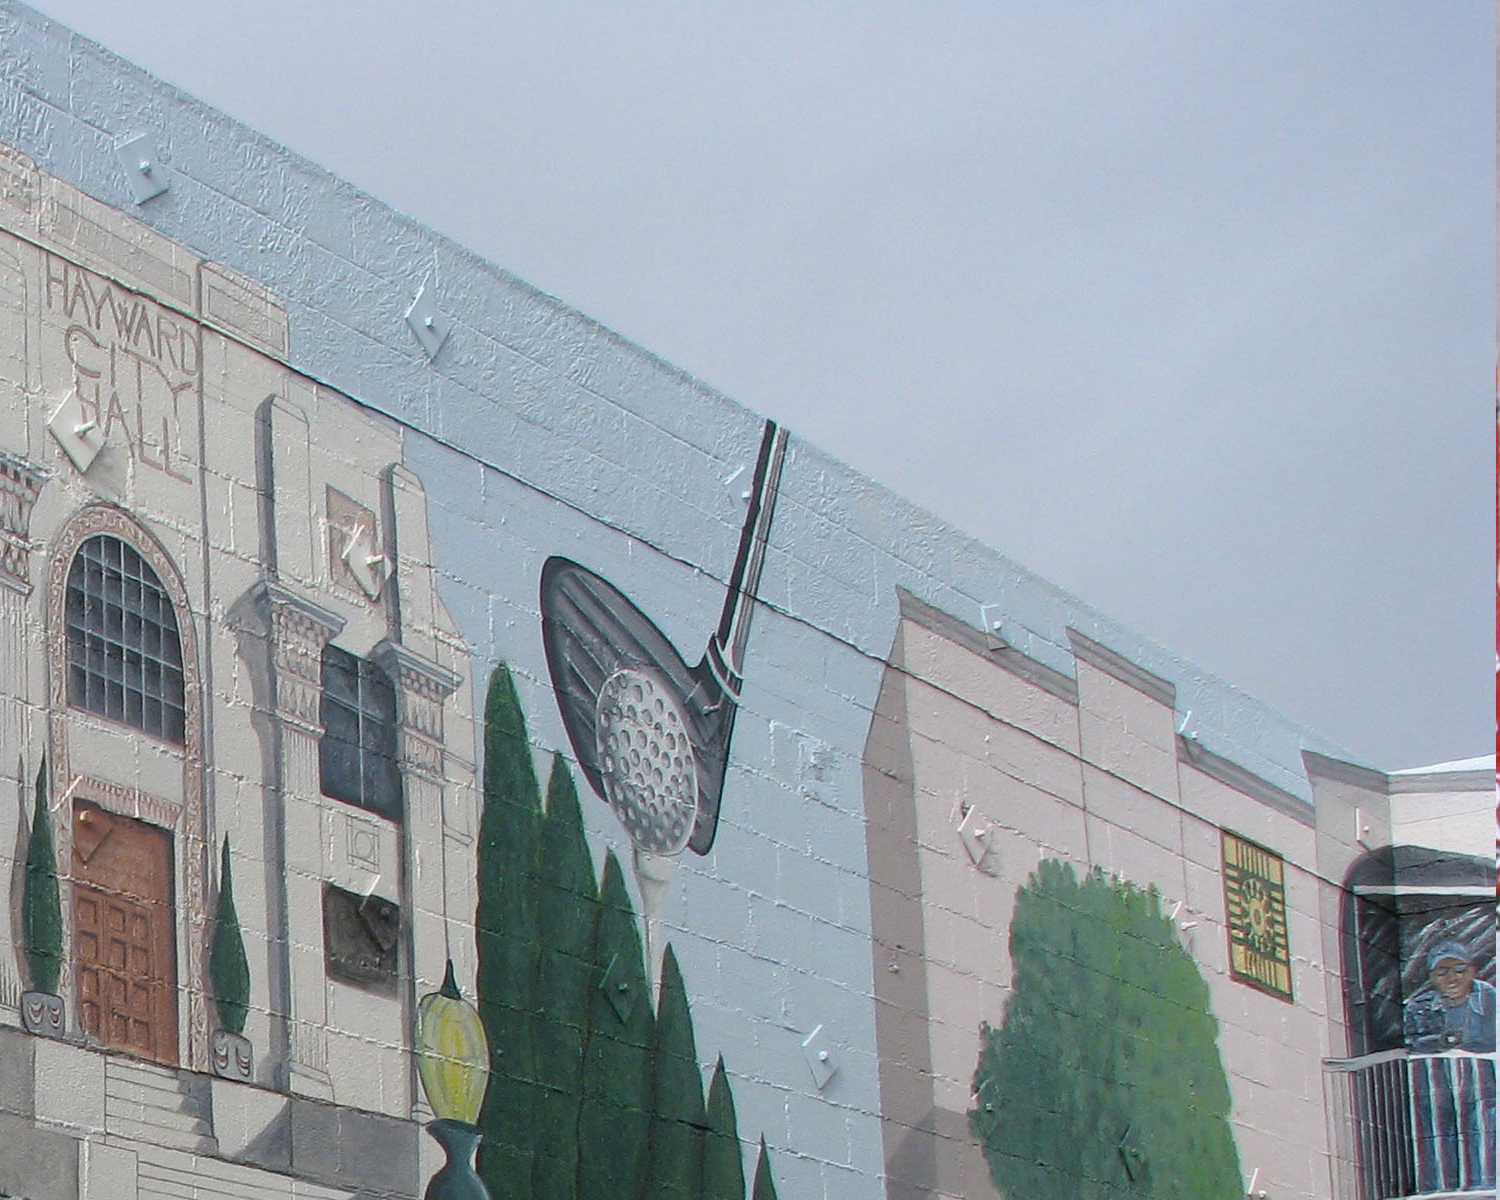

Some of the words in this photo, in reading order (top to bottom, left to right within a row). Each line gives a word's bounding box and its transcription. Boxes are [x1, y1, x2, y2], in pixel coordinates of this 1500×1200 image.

[45, 251, 199, 376] HAYWARD
[64, 324, 192, 422] CITY
[76, 375, 192, 485] HALL
